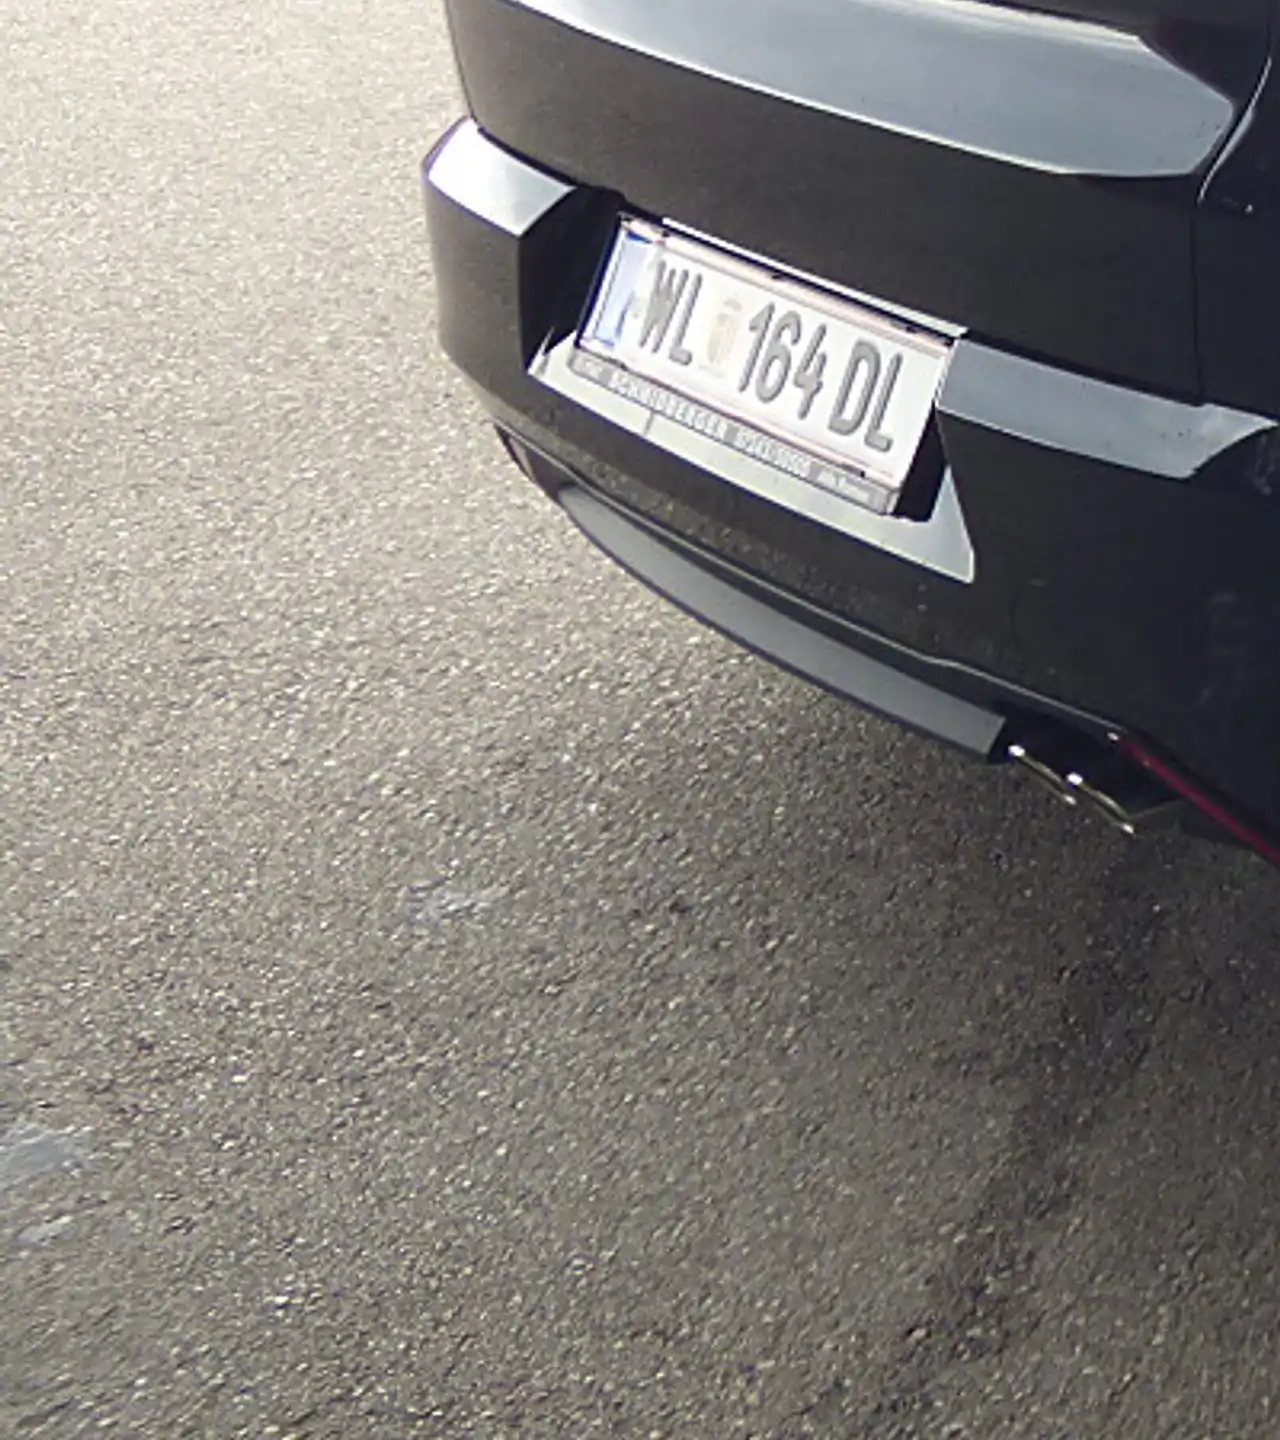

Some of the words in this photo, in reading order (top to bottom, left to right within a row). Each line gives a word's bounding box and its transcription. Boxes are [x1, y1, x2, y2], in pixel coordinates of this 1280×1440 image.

[638, 258, 703, 366] WL
[738, 301, 829, 422] 164
[827, 338, 904, 453] DL
